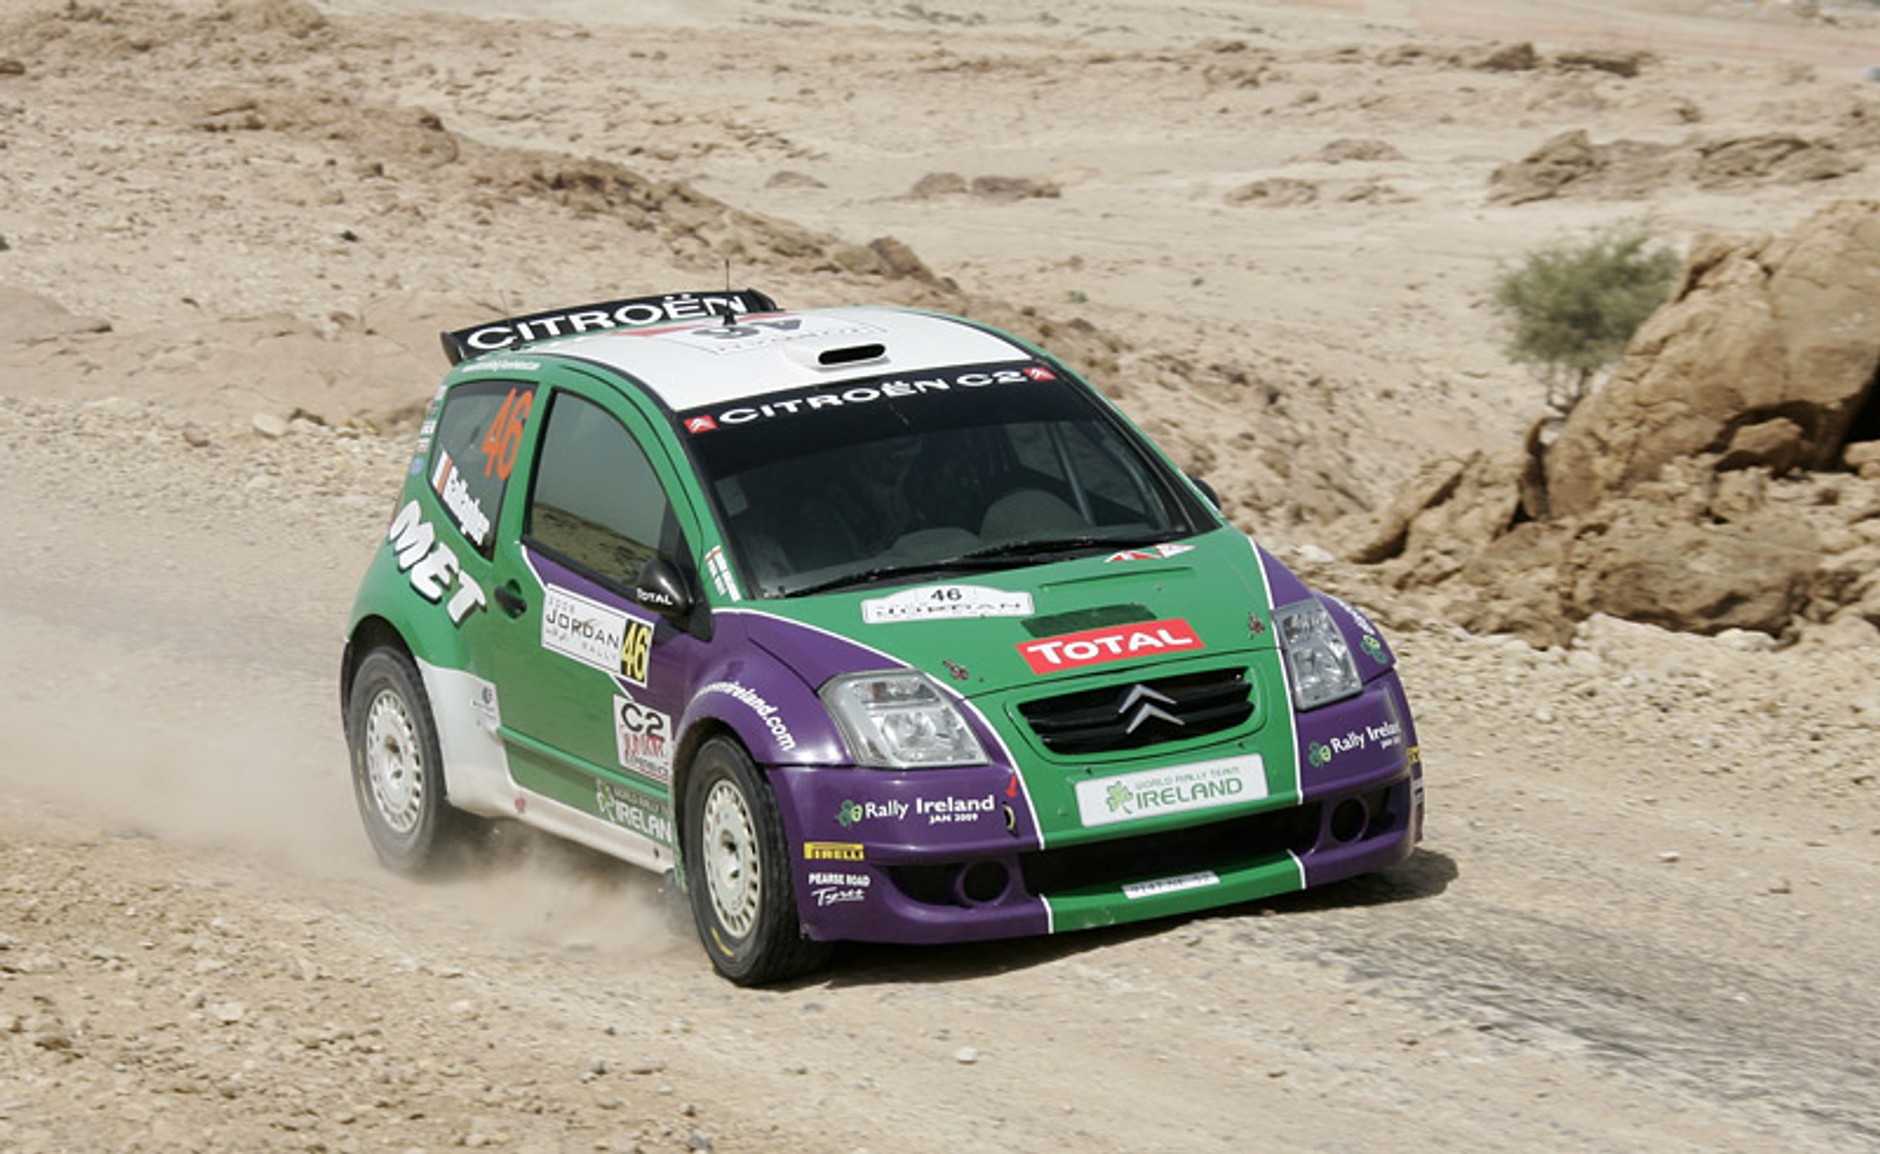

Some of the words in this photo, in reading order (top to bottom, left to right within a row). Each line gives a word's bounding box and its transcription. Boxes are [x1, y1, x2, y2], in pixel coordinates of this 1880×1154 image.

[467, 294, 748, 350] CITROËN
[718, 377, 951, 425] CITROËN
[955, 370, 1027, 388] C2
[481, 387, 534, 480] 46
[389, 499, 487, 628] MET
[636, 587, 674, 606] TOTAL
[930, 587, 962, 601] 46
[545, 608, 620, 649] JORDAN
[622, 622, 650, 681] 46
[1026, 629, 1194, 665] TOTAL
[620, 702, 665, 742] C2
[1330, 731, 1365, 753] Rally
[865, 800, 909, 821] Rally
[916, 794, 996, 814] Ireland
[1136, 777, 1243, 810] IRELAND
[928, 813, 952, 826] JAN
[804, 842, 865, 861] PIRELLI
[808, 873, 845, 886] PEARSE
[846, 874, 872, 887] ROAD
